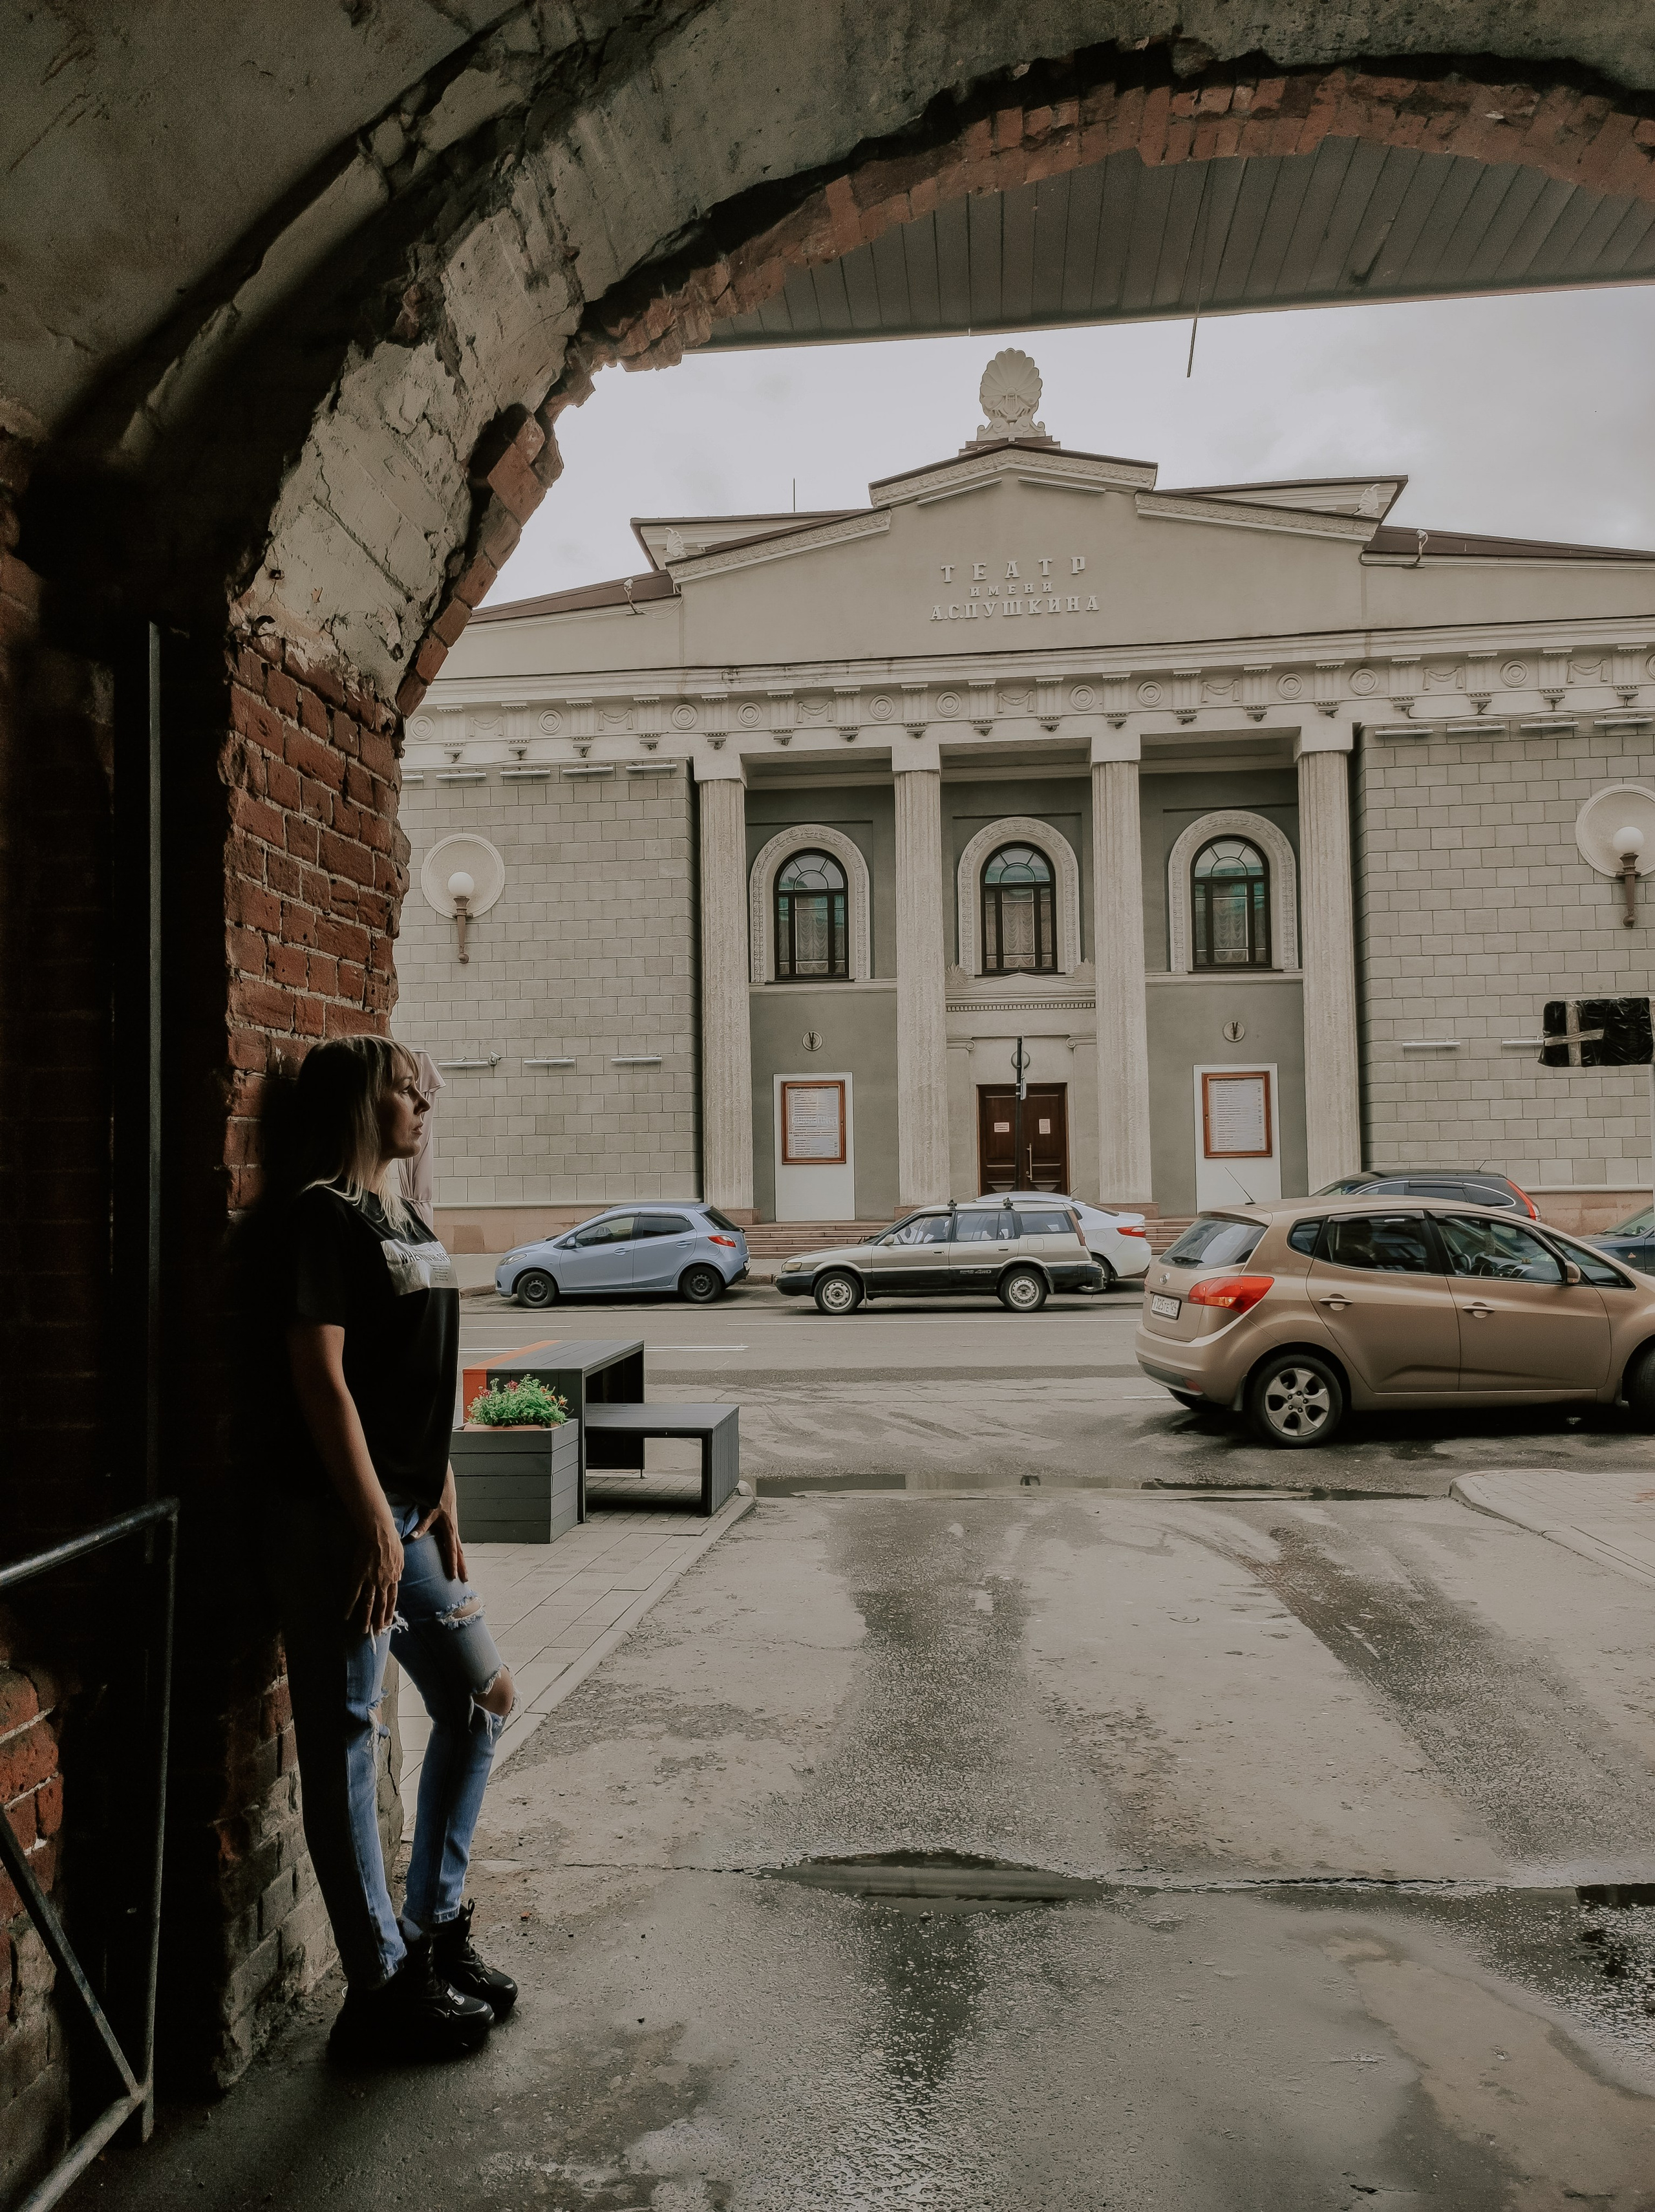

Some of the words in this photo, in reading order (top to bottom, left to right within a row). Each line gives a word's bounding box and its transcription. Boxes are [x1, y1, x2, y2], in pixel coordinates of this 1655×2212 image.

[940, 556, 1085, 583] ТЕАТР
[970, 582, 1053, 597] ИМЕНИ
[929, 596, 1100, 621] А.С.ПУШКИНА
